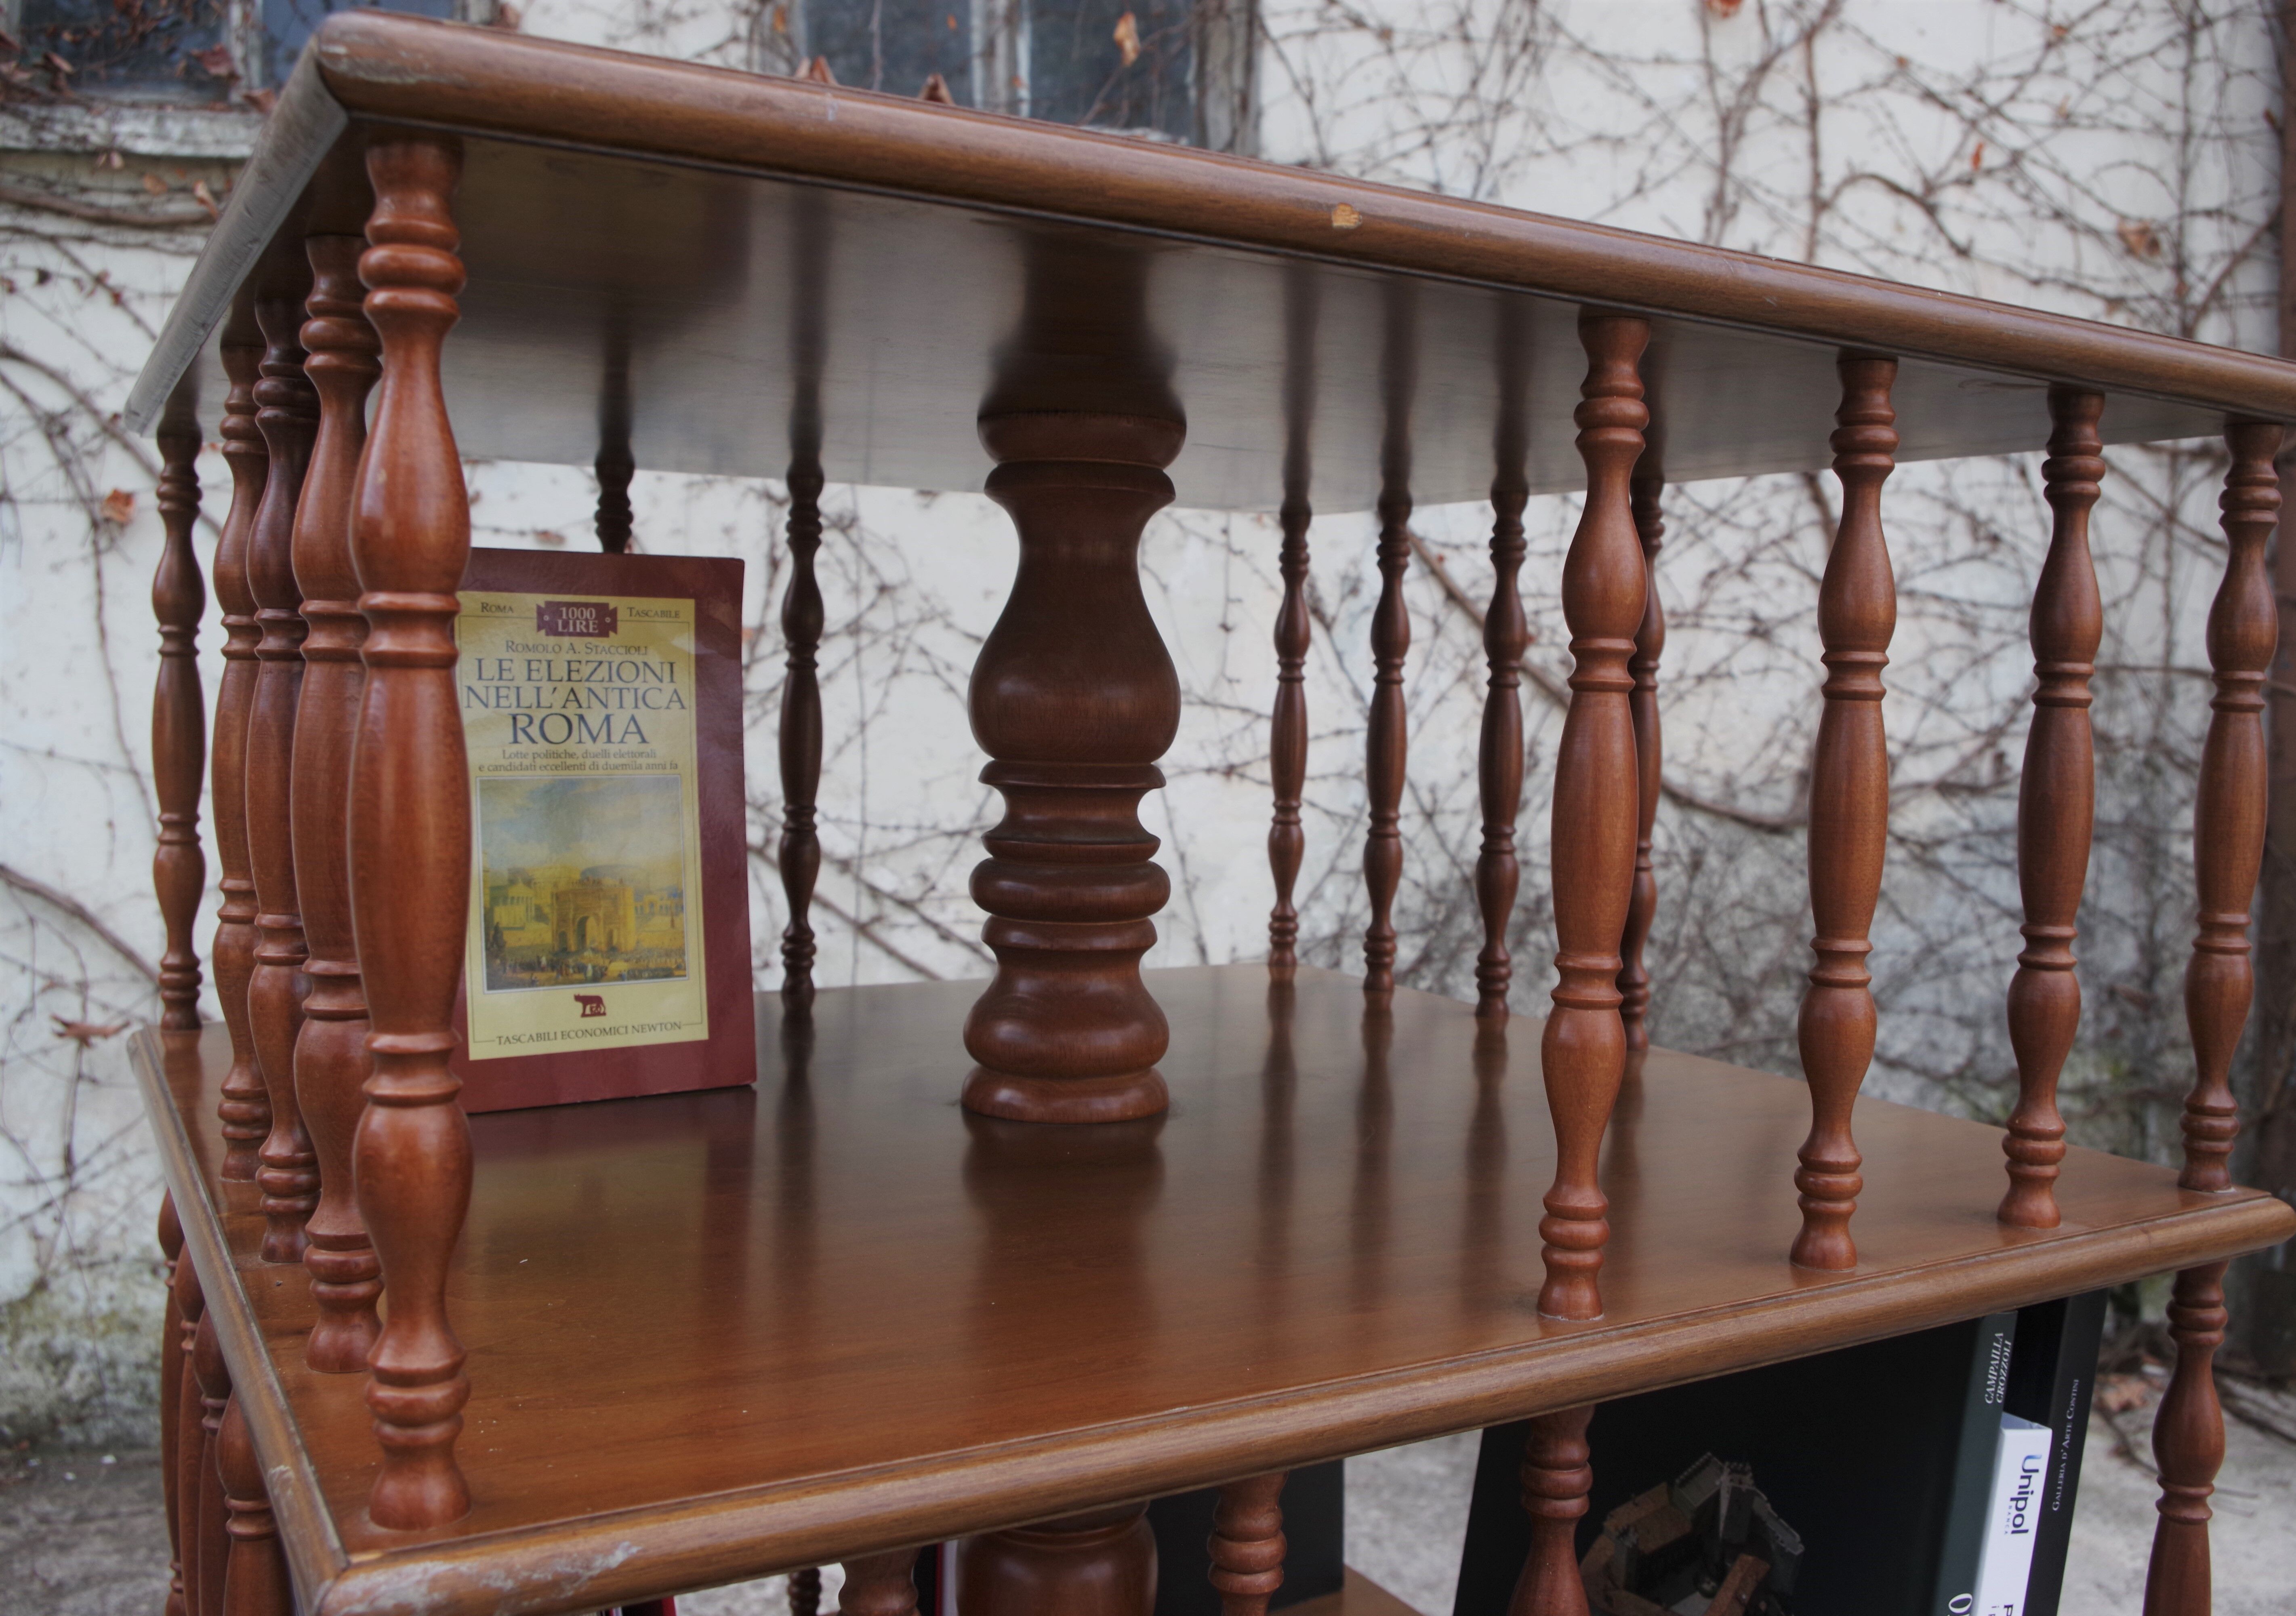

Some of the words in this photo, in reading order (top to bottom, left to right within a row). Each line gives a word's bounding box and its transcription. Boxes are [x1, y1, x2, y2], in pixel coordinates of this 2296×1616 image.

[557, 619, 599, 633] LIRE
[560, 607, 596, 620] 1000
[566, 642, 580, 654] A.
[475, 658, 515, 681] LE
[525, 659, 676, 684] ELEZIONI
[465, 685, 687, 710] NELL'ANTICA
[508, 713, 650, 745] ROMA
[487, 761, 537, 772] candidati
[539, 761, 586, 771] eccellenti
[588, 761, 599, 771] di
[601, 760, 643, 770] duemila
[645, 760, 667, 770] anni
[669, 760, 679, 770] fa
[503, 749, 529, 759] Lotte
[532, 749, 579, 763] politiche,
[581, 749, 610, 759] duelli
[613, 749, 657, 759] elettorali
[496, 1031, 558, 1046] TASCABILI
[561, 1025, 629, 1041] ECONOMICI
[631, 1021, 682, 1034] NEWTON
[1984, 1332, 2004, 1404] CAMPAILLA
[1996, 1340, 2012, 1404] CROZZOLI
[2010, 1454, 2042, 1534] Unipol
